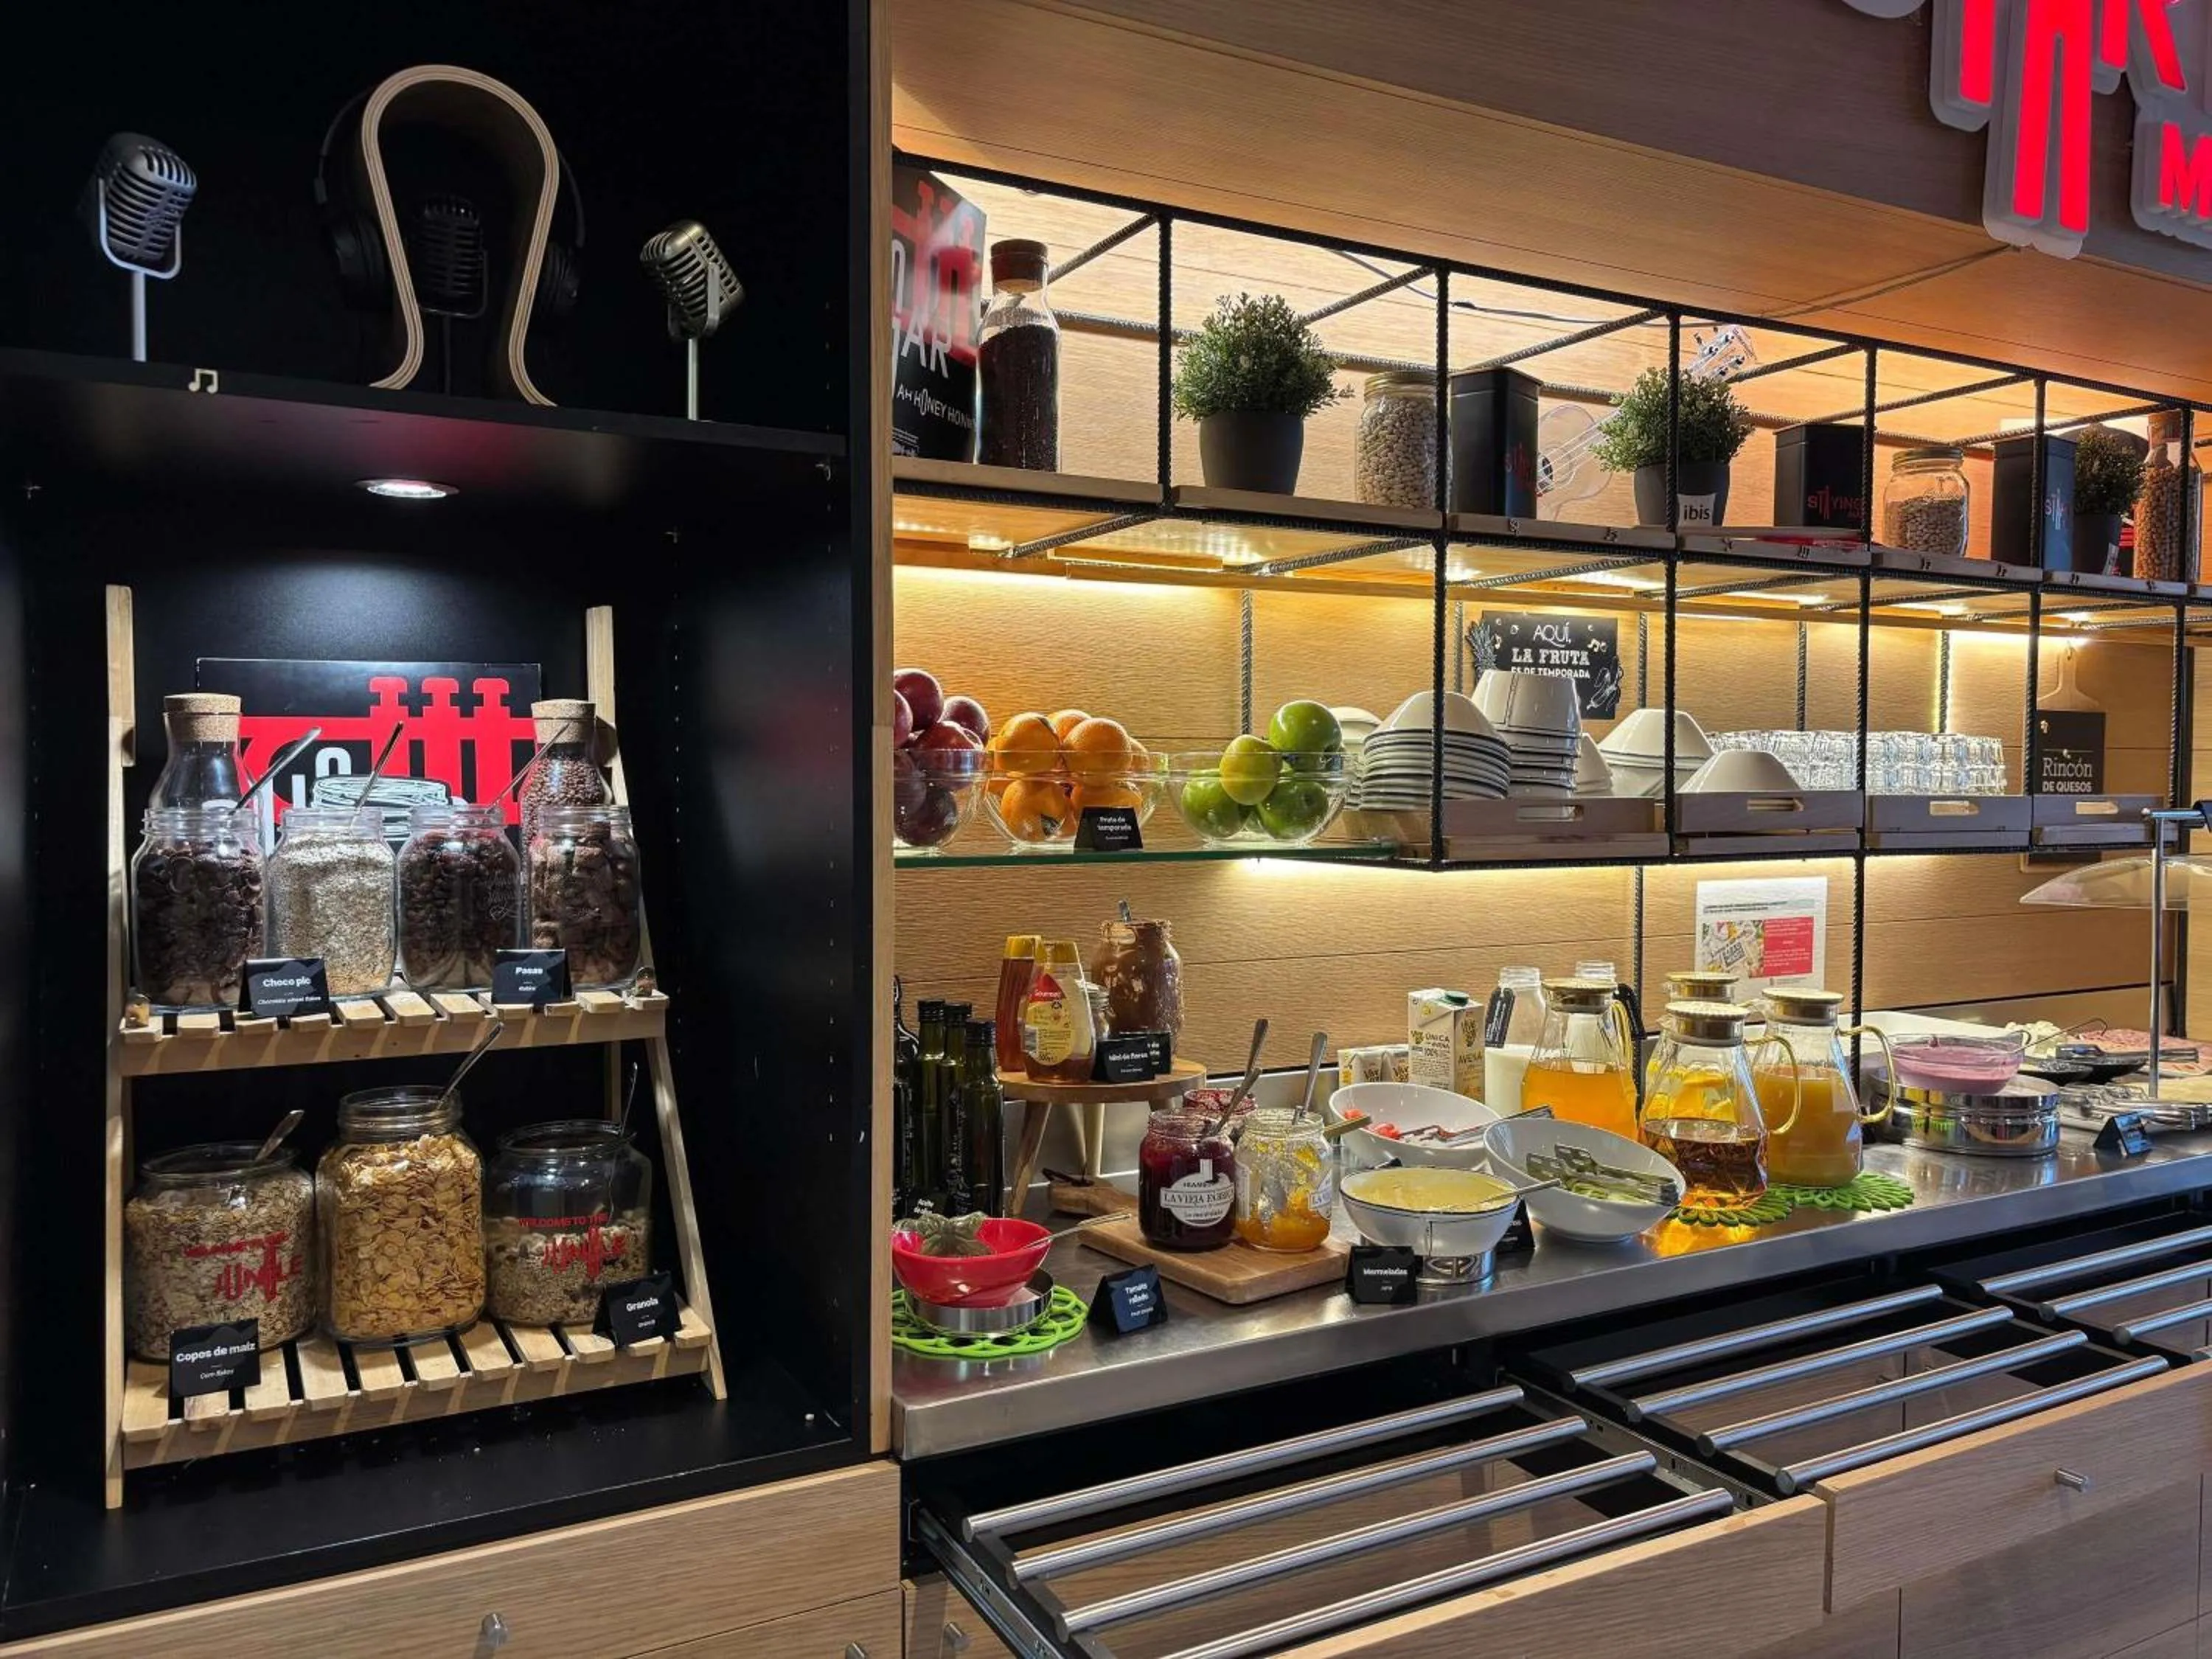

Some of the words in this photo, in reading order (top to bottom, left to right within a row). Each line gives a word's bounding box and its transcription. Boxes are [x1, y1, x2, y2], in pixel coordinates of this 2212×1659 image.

[914, 388, 947, 418] HONEY
[1684, 504, 1710, 521] ibis
[1512, 648, 1534, 664] LA
[1539, 649, 1590, 666] FRUTA
[1537, 667, 1590, 679] TEMPORADA
[2042, 757, 2093, 777] Rincón
[2042, 781, 2055, 793] DE
[2056, 782, 2092, 793] QUESOS
[262, 977, 295, 987] Choco
[627, 1297, 658, 1312] Granola
[176, 1349, 212, 1362] Copos
[213, 1345, 228, 1356] de
[229, 1340, 257, 1354] maíz
